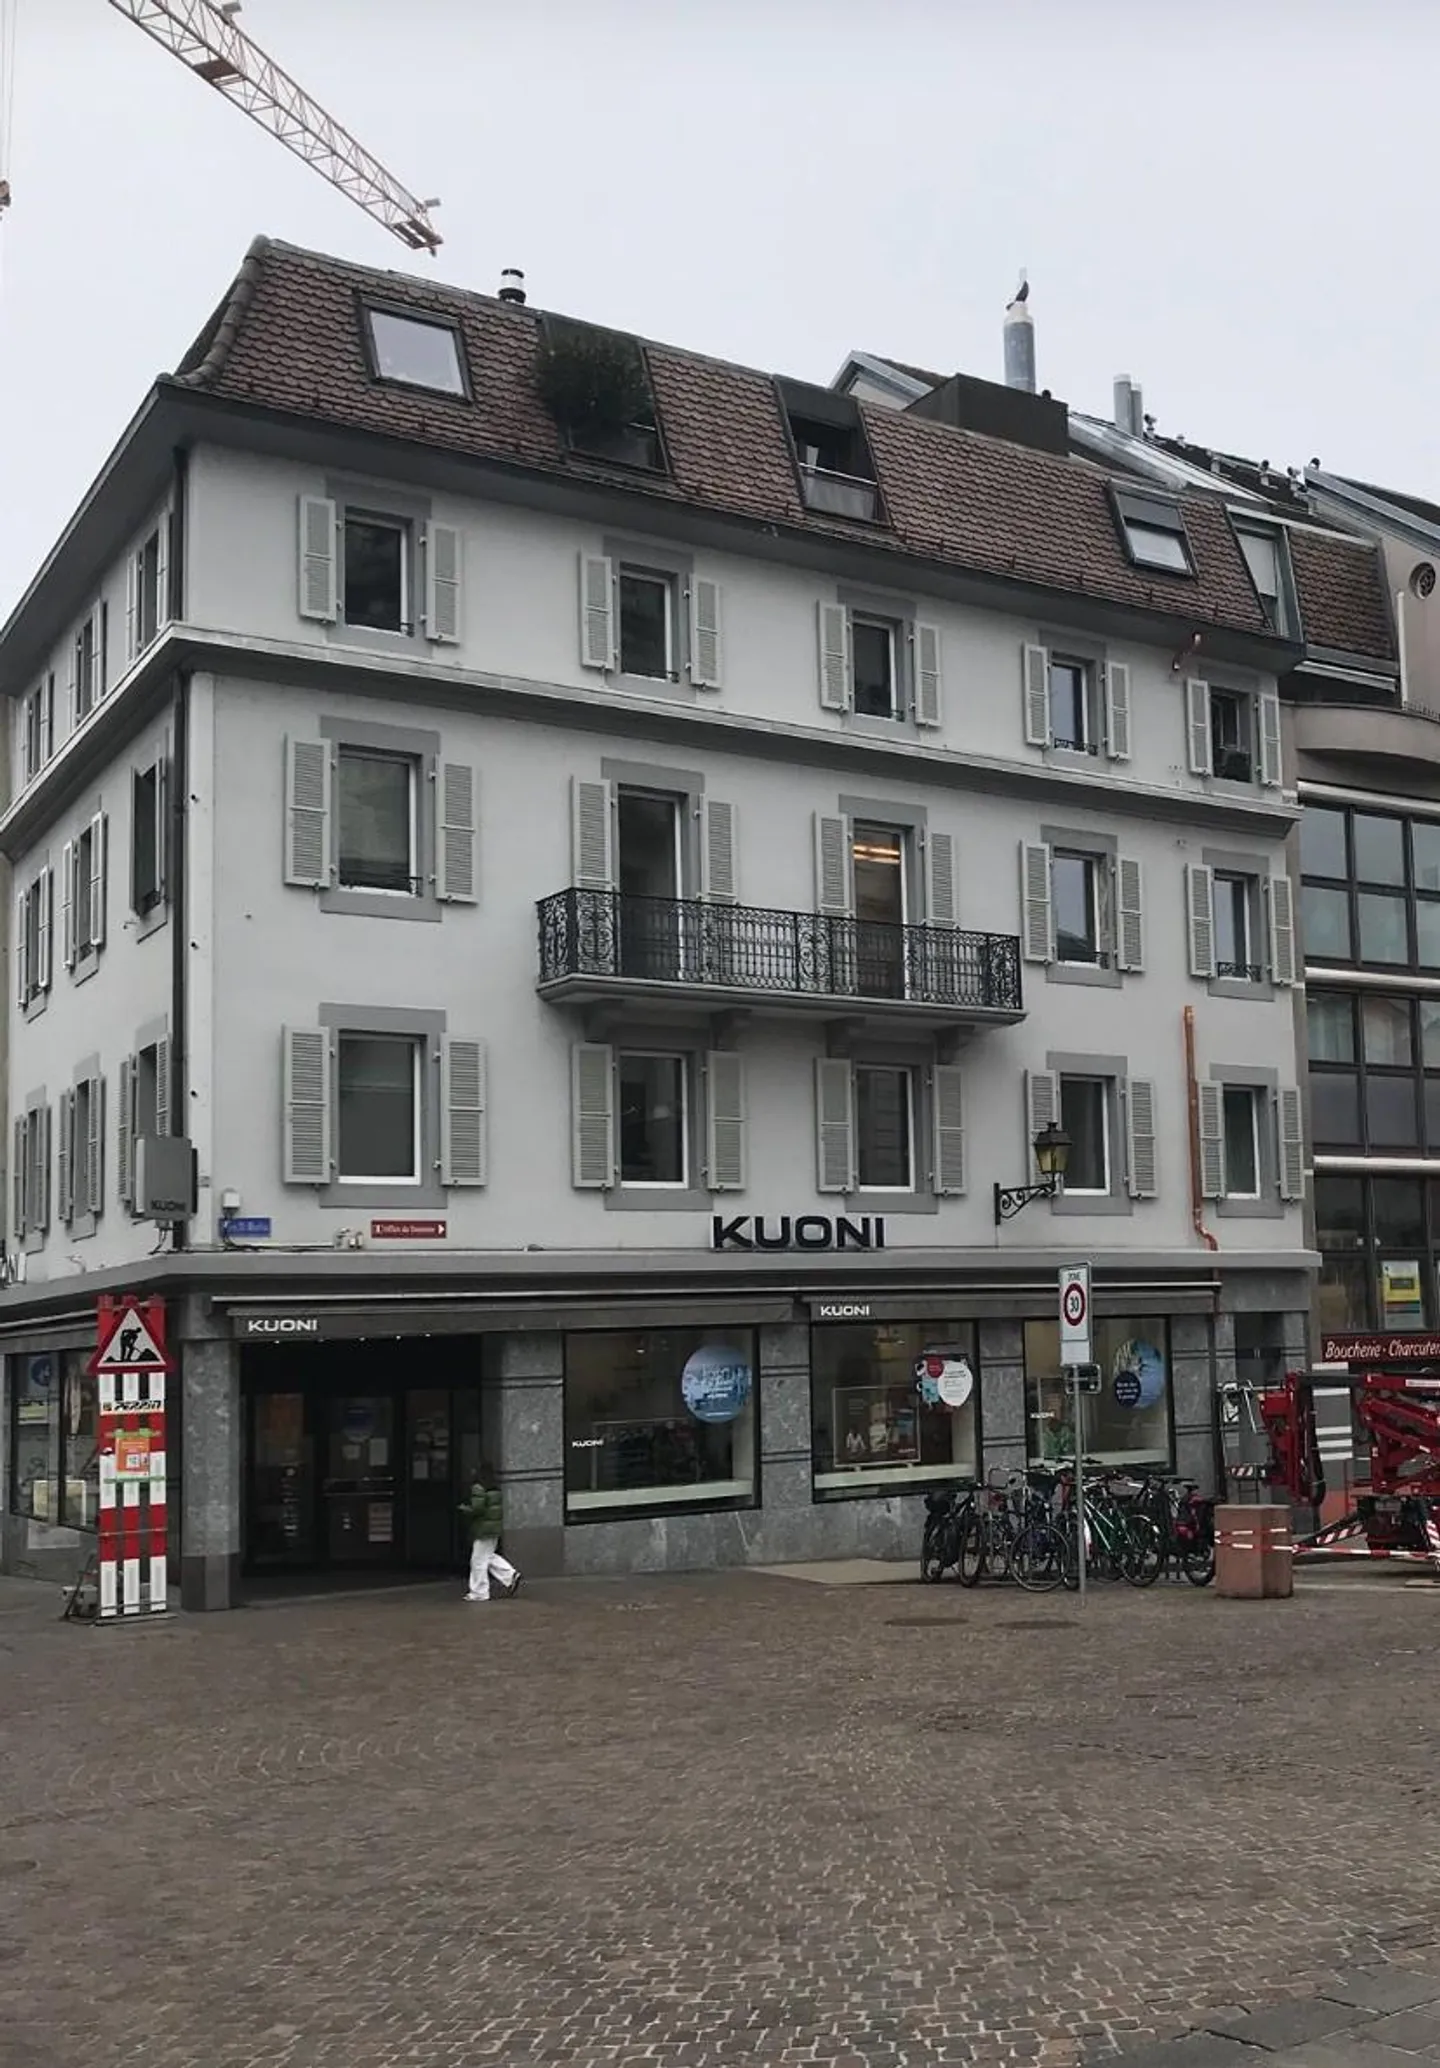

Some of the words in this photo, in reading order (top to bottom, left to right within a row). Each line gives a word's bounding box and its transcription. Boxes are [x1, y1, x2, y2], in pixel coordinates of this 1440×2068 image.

[713, 1215, 884, 1249] KUONI
[820, 1305, 869, 1316] KUONI
[1070, 1296, 1080, 1313] 30
[248, 1319, 317, 1332] KUONI
[1325, 1340, 1381, 1359] Boucherie
[572, 1439, 604, 1449] KUONI
